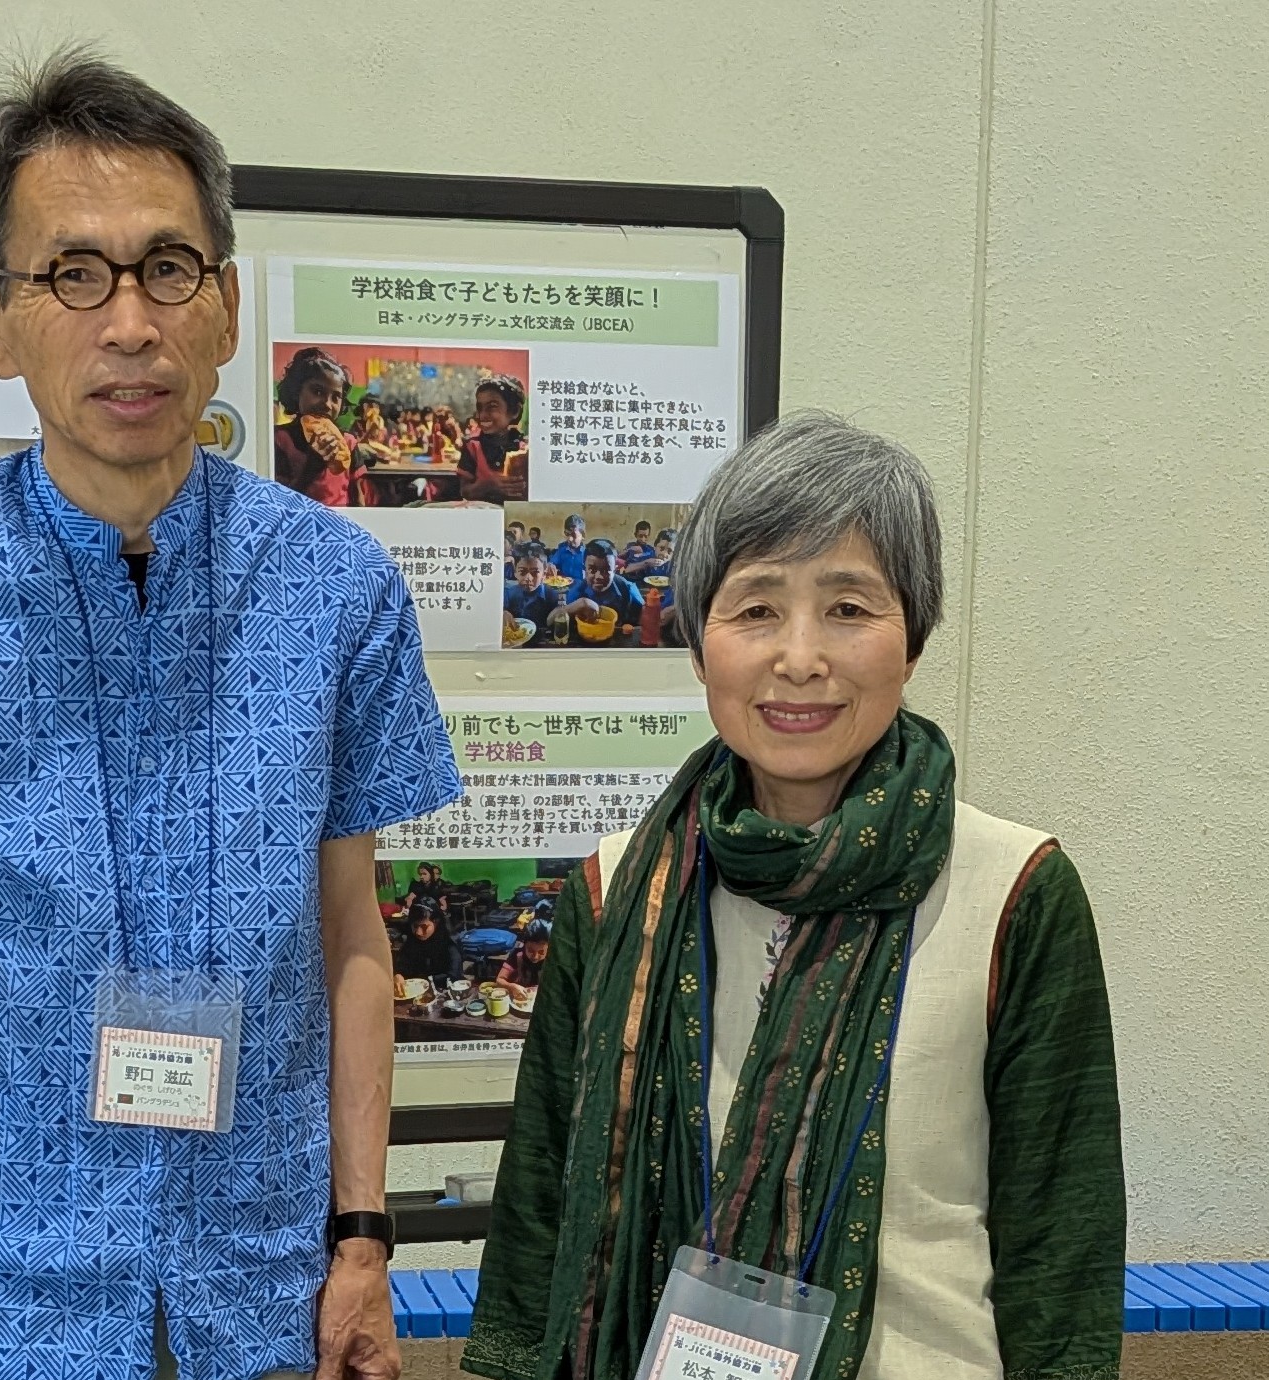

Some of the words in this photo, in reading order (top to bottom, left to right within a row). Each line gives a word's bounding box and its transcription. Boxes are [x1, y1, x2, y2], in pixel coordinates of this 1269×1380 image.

[351, 276, 660, 308] 学校給食で子どもたちを笑顔に！
[377, 311, 635, 333] 日本・バングラデシュ文化交流会（JBCEA）
[536, 380, 647, 397] 学校給食がないと、
[549, 450, 665, 465] 戻らない場合がある
[390, 546, 501, 560] 学校給食に取り組み、
[395, 562, 493, 576] 村部シャシャ郡
[415, 597, 472, 610] ています。
[465, 740, 546, 763] 学校給食
[374, 836, 550, 851] 面に大きな影響を与えています。
[125, 1066, 154, 1083] 野口
[164, 1069, 194, 1087] 滋広
